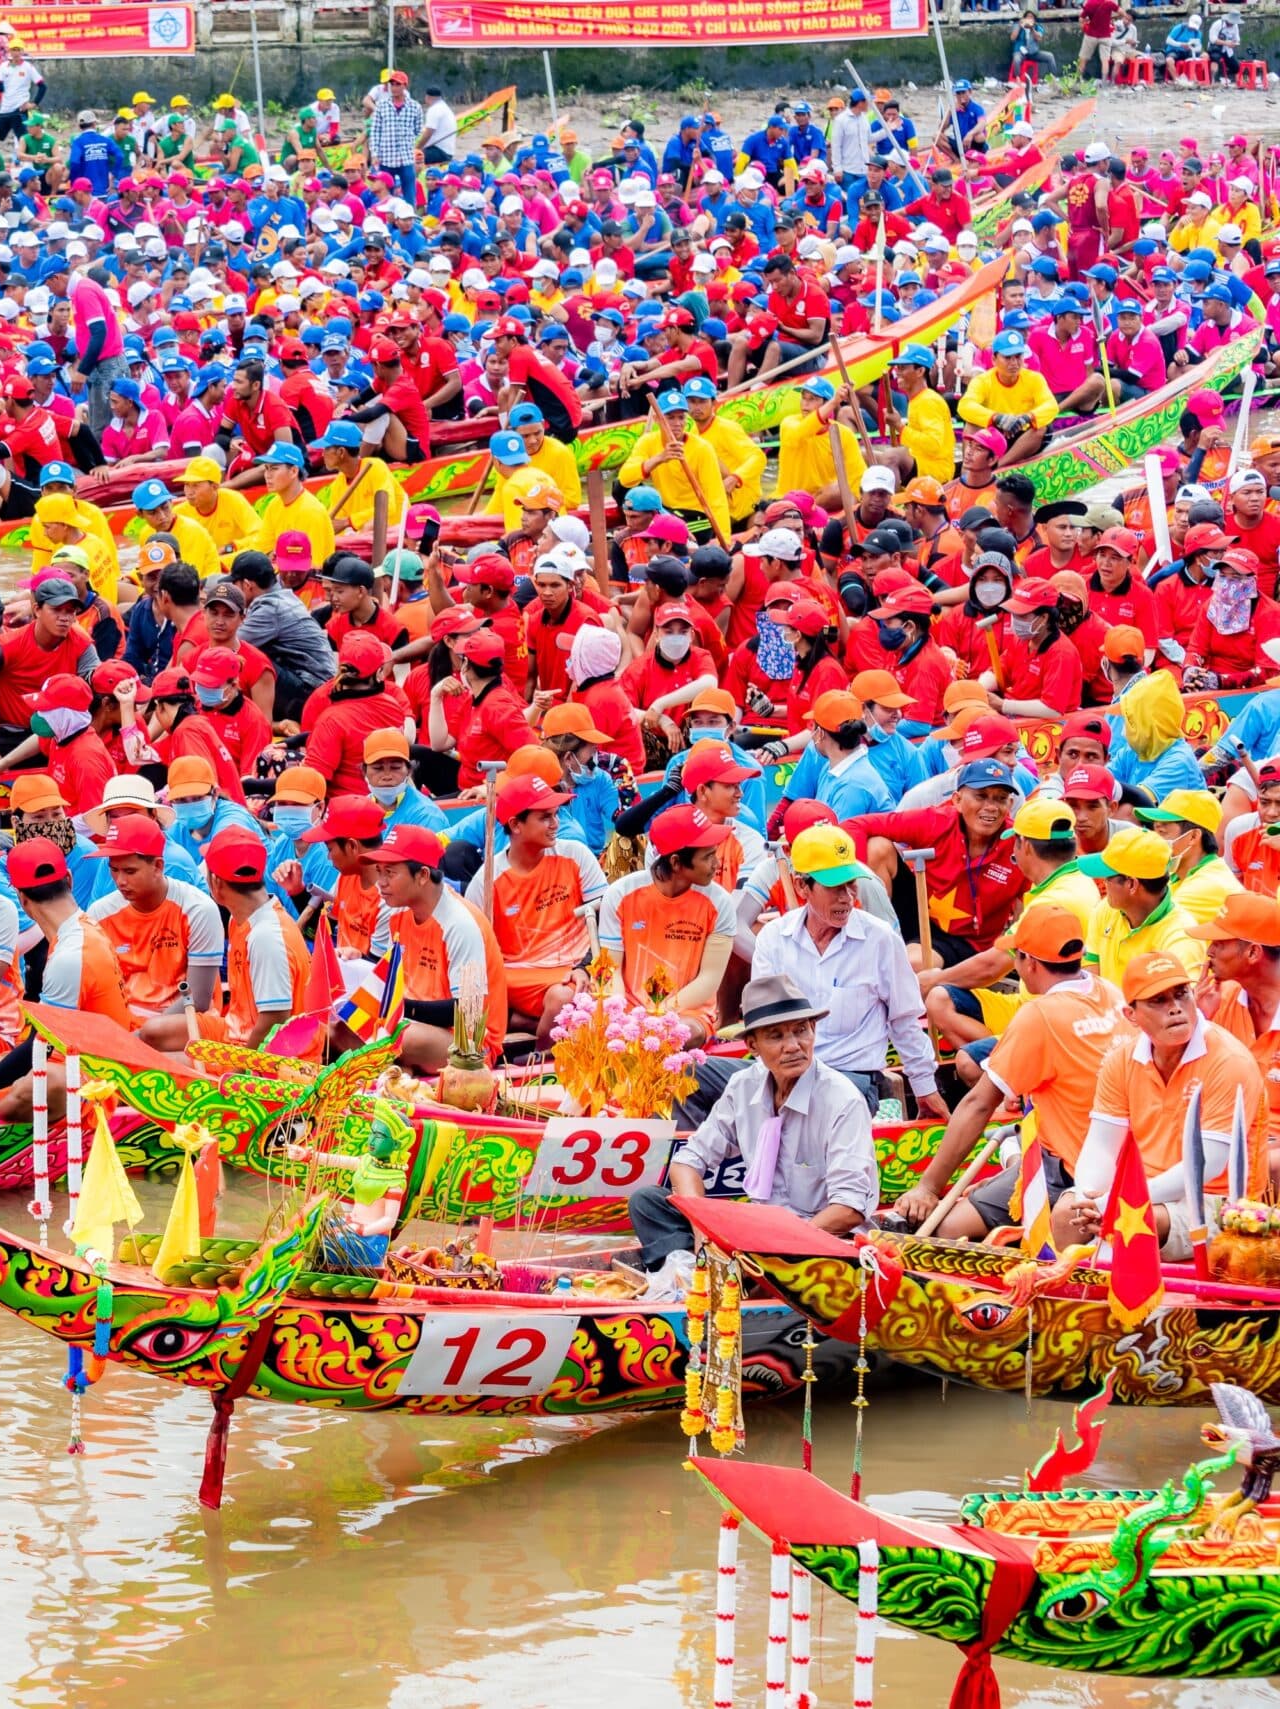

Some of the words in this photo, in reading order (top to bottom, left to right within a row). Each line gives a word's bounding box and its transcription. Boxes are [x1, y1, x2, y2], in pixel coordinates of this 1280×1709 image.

[481, 22, 515, 35] LUÔN
[557, 23, 583, 35] CAO
[730, 17, 747, 33] VÀ
[860, 14, 882, 29] TỘC
[573, 5, 602, 18] VIÊN
[634, 6, 658, 18] GHE
[661, 5, 687, 17] NGO
[551, 1129, 651, 1186] 33
[443, 1327, 547, 1387] 12
